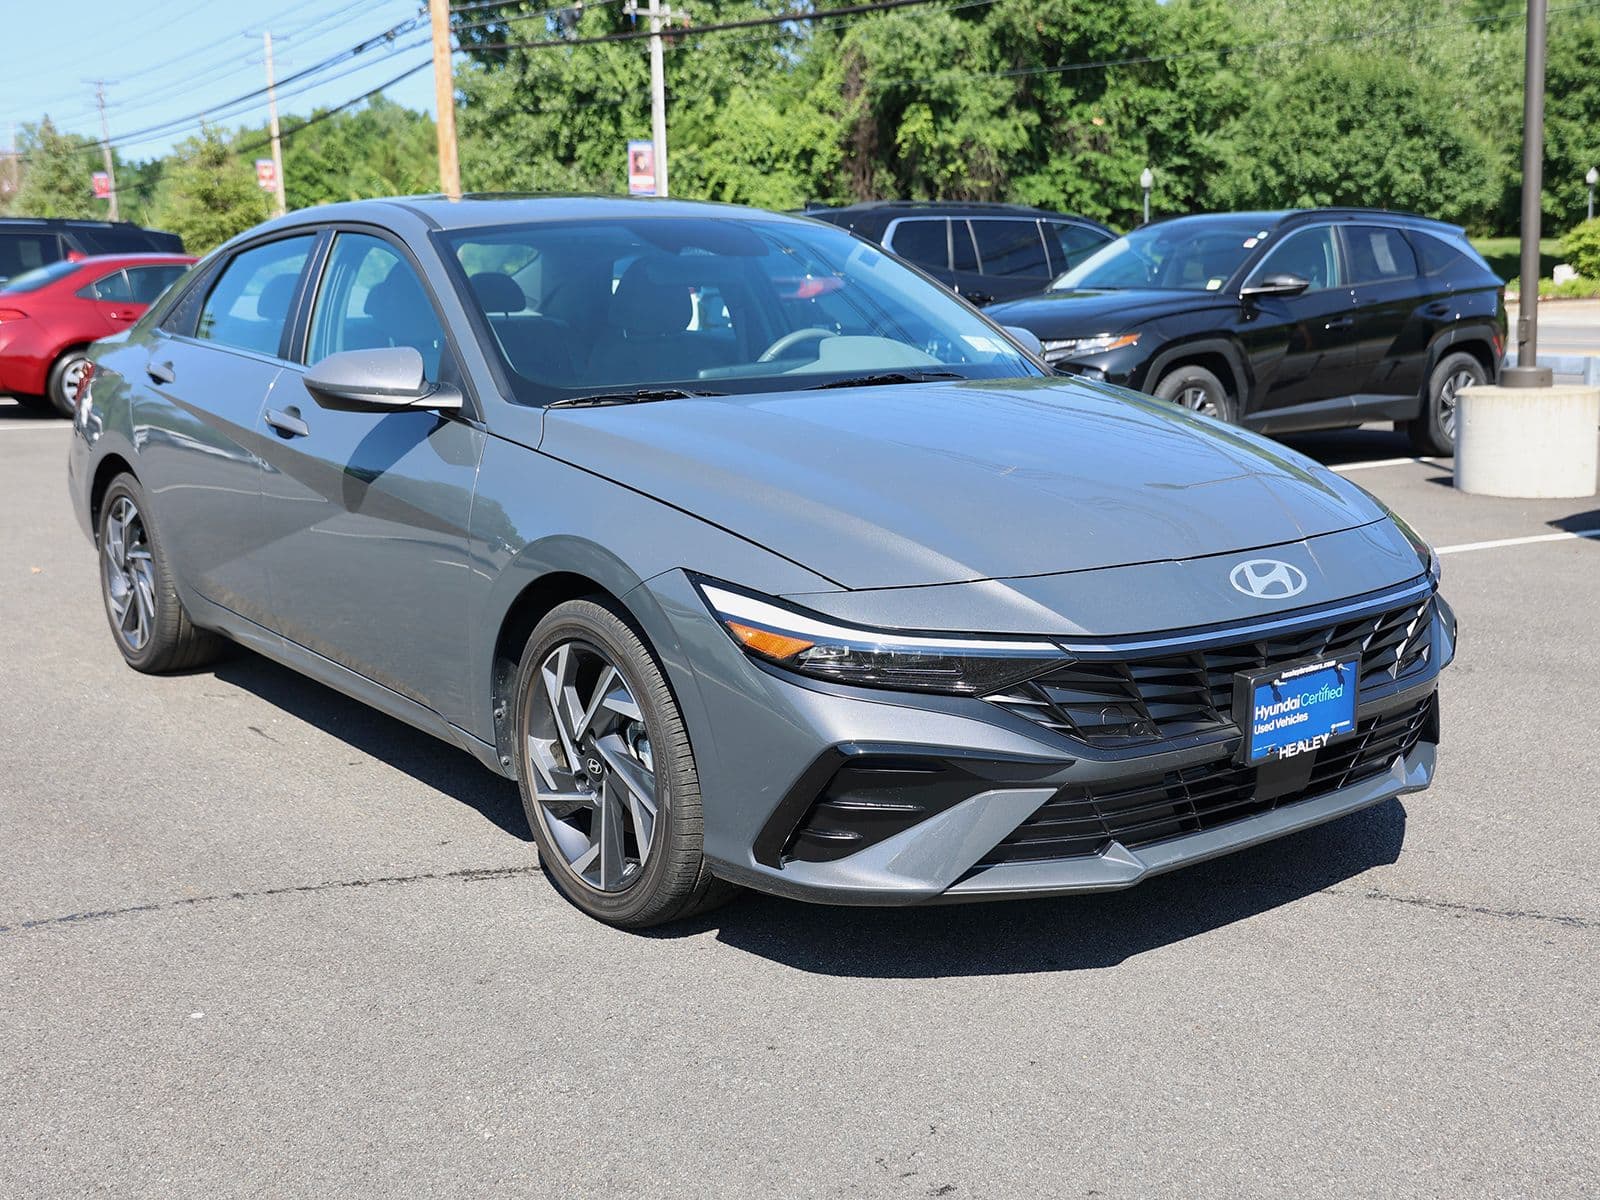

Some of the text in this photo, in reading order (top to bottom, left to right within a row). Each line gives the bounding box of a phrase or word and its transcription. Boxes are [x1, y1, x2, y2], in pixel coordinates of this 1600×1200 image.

[1255, 683, 1343, 721] Hyundai Certified
[1254, 712, 1309, 735] Used Vehicles
[1279, 732, 1330, 760] HEALEY
